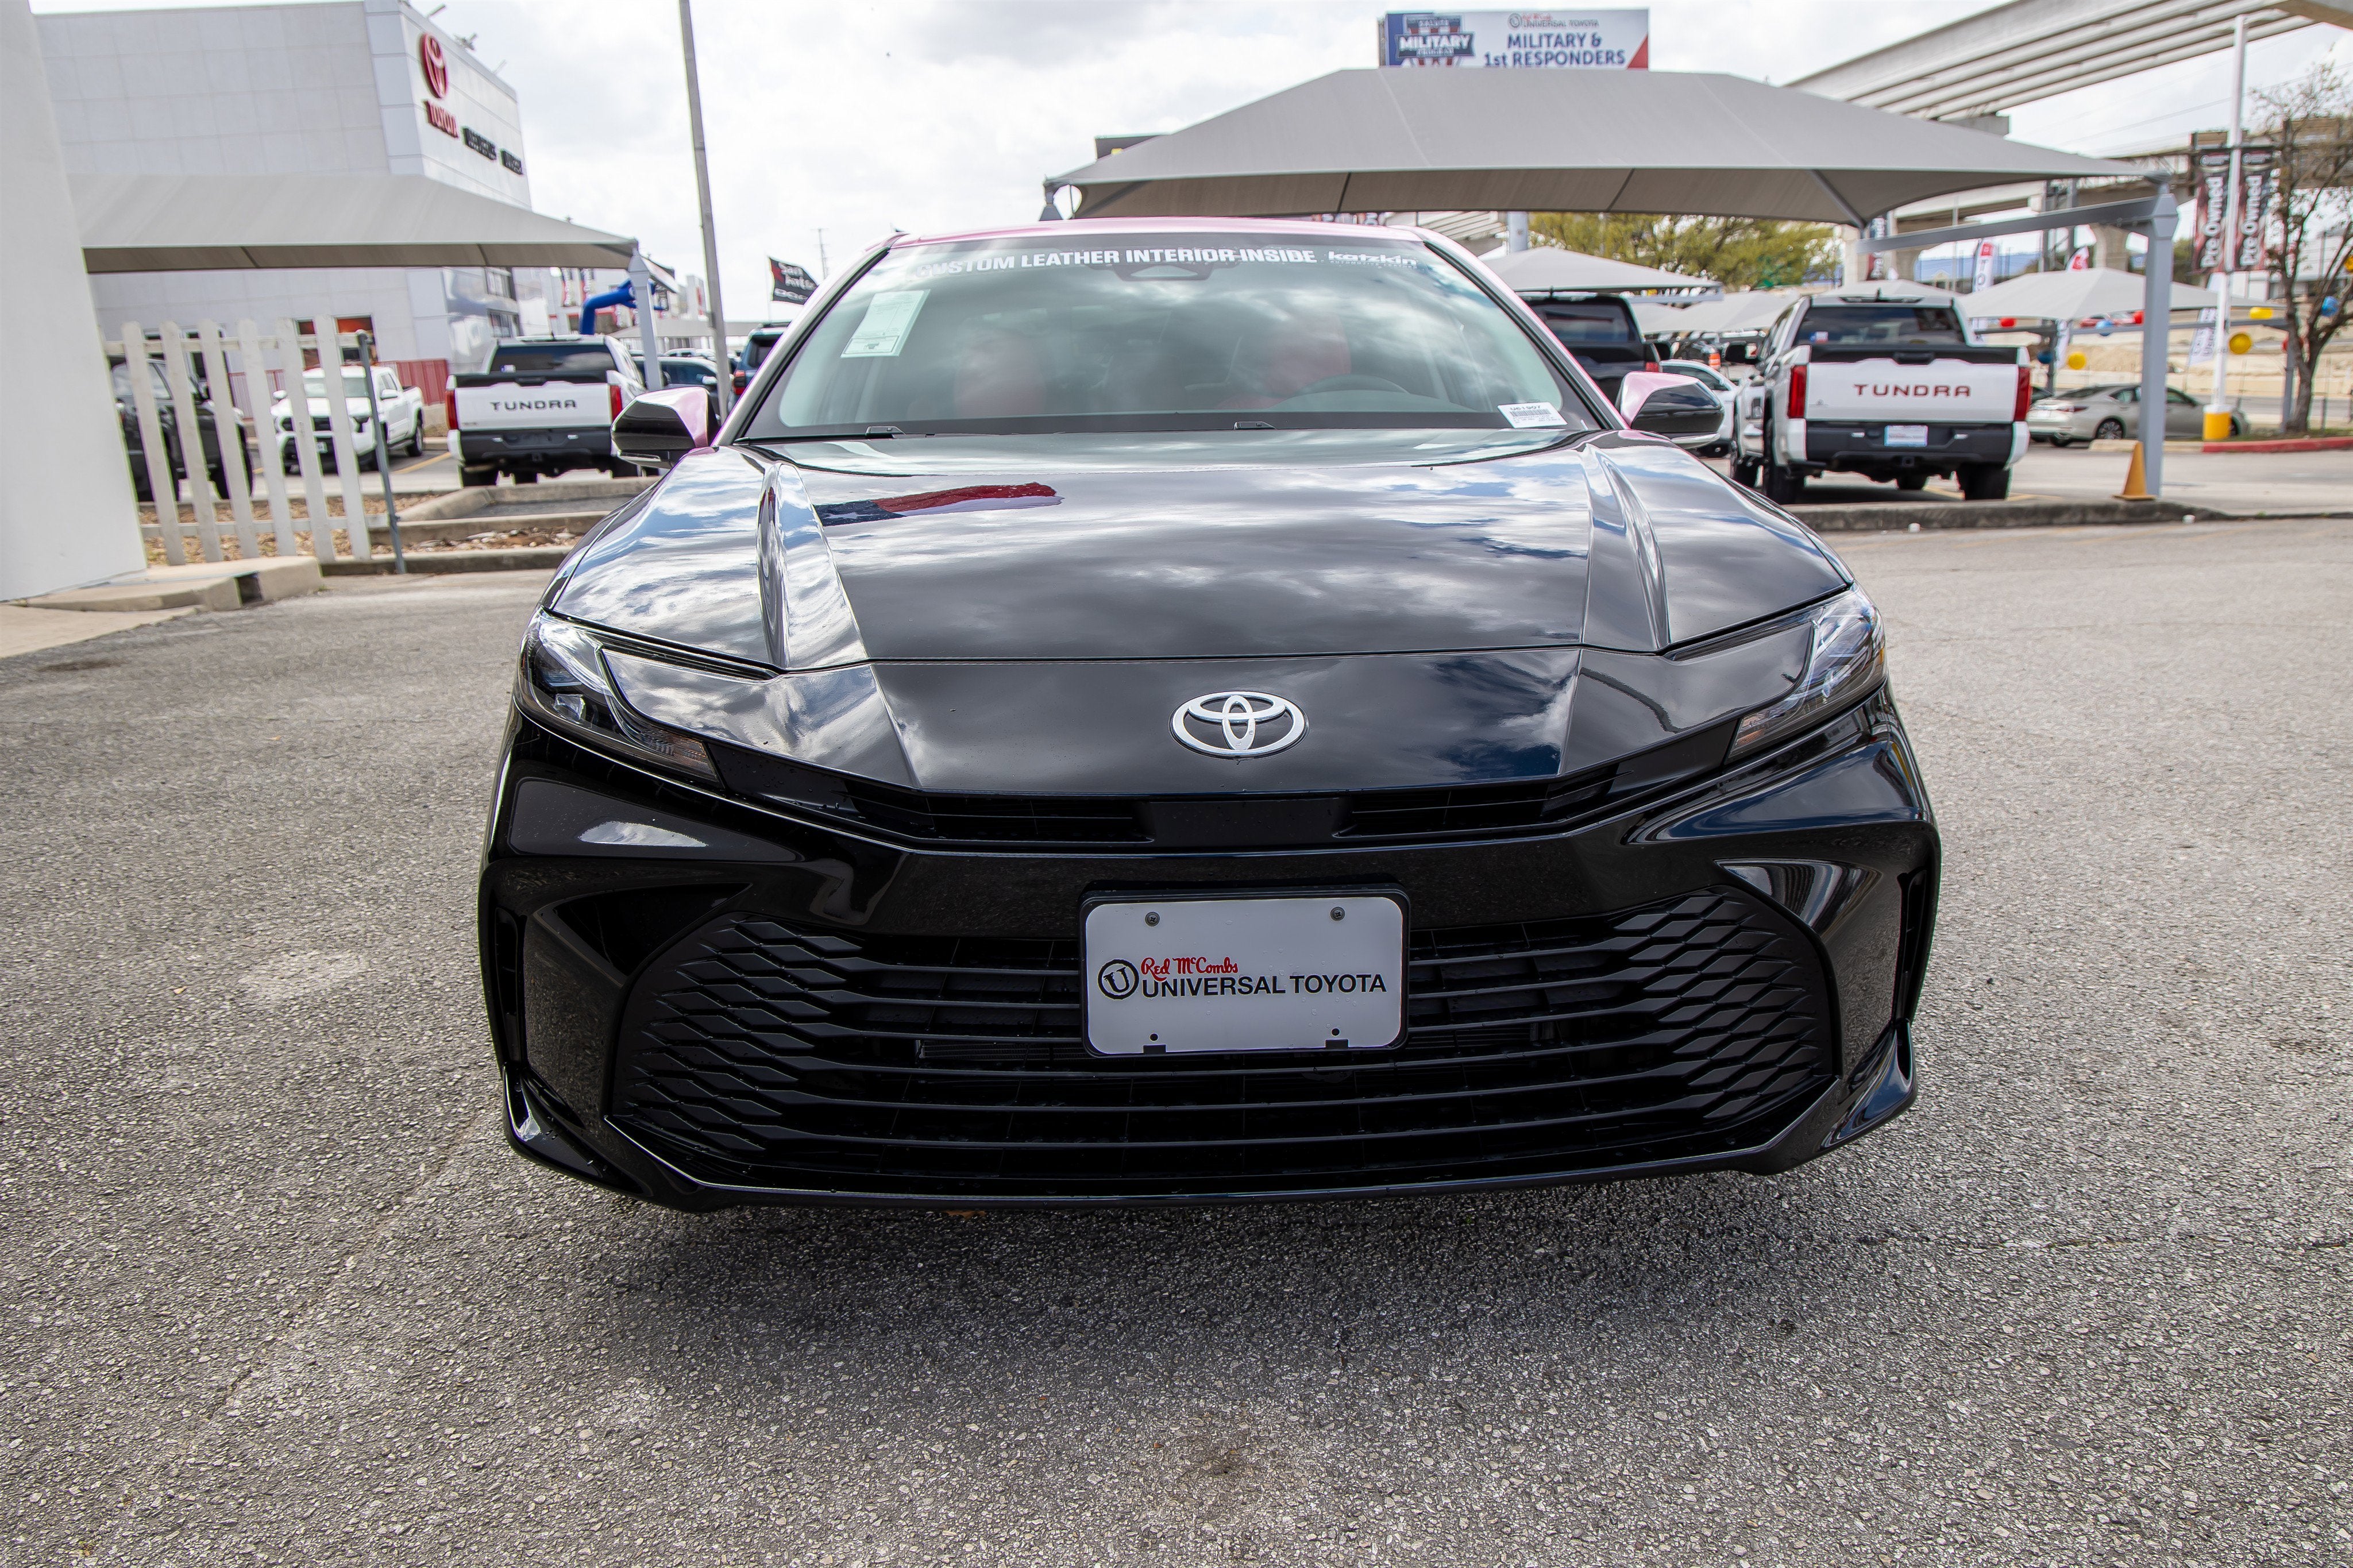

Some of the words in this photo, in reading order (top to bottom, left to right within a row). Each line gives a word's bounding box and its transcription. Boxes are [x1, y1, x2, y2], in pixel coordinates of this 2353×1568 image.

[1398, 34, 1471, 51] MILITARY
[1508, 32, 1587, 48] MILITARY
[1591, 32, 1603, 47] &
[1484, 51, 1508, 68] 1st
[1513, 49, 1626, 65] RESPONDERS
[2203, 176, 2224, 237] Owned
[2242, 175, 2263, 235] Owned
[916, 256, 1015, 277] CUSTOM
[1021, 249, 1120, 268] LEATHER
[1125, 249, 1235, 263] INTERIOR
[1239, 249, 1318, 263] INSIDE
[2200, 237, 2219, 268] Pre
[2239, 237, 2258, 266] Pre
[1853, 383, 1971, 397] TUNDRA
[490, 399, 577, 411] TUNDRA
[1140, 957, 1170, 982] Red
[1172, 956, 1239, 975] McCombs
[1142, 975, 1286, 998] UNIVERSAL
[1289, 974, 1387, 994] TOYOTA
